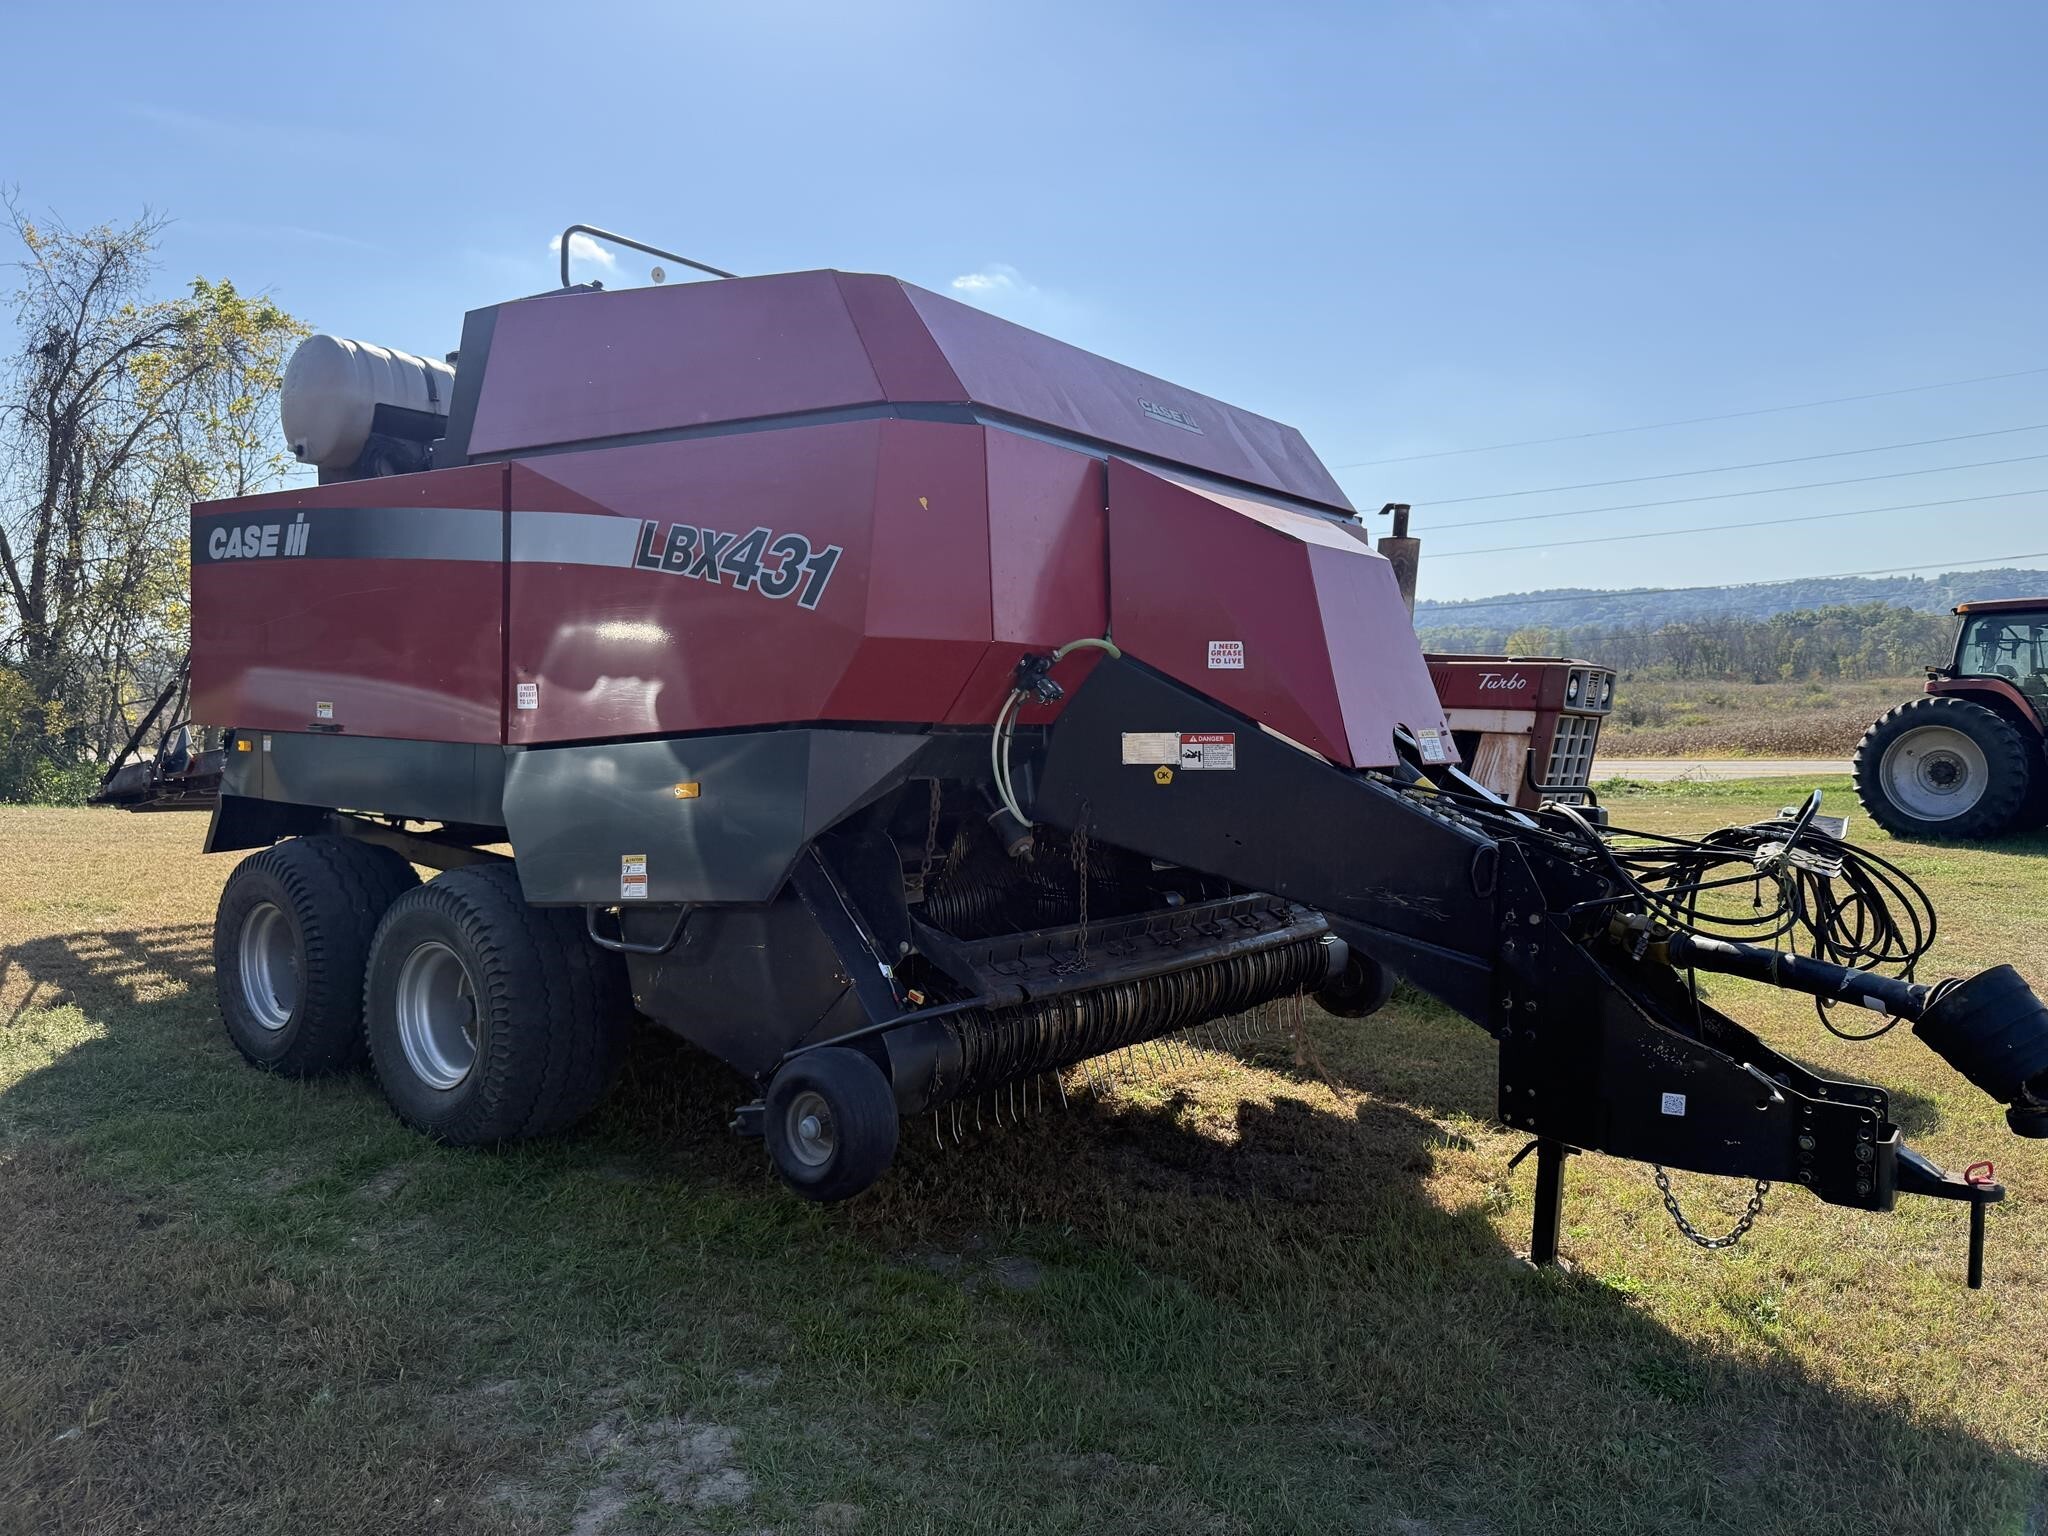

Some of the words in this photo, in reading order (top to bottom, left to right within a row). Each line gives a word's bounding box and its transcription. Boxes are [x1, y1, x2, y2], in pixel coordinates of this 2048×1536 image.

[1137, 397, 1183, 423] CASE
[208, 524, 280, 560] CASE
[635, 519, 843, 611] LBX431
[1210, 657, 1222, 665] TO
[1223, 657, 1242, 665] LIVE
[1478, 672, 1527, 690] Turbo
[1156, 771, 1169, 780] OK
